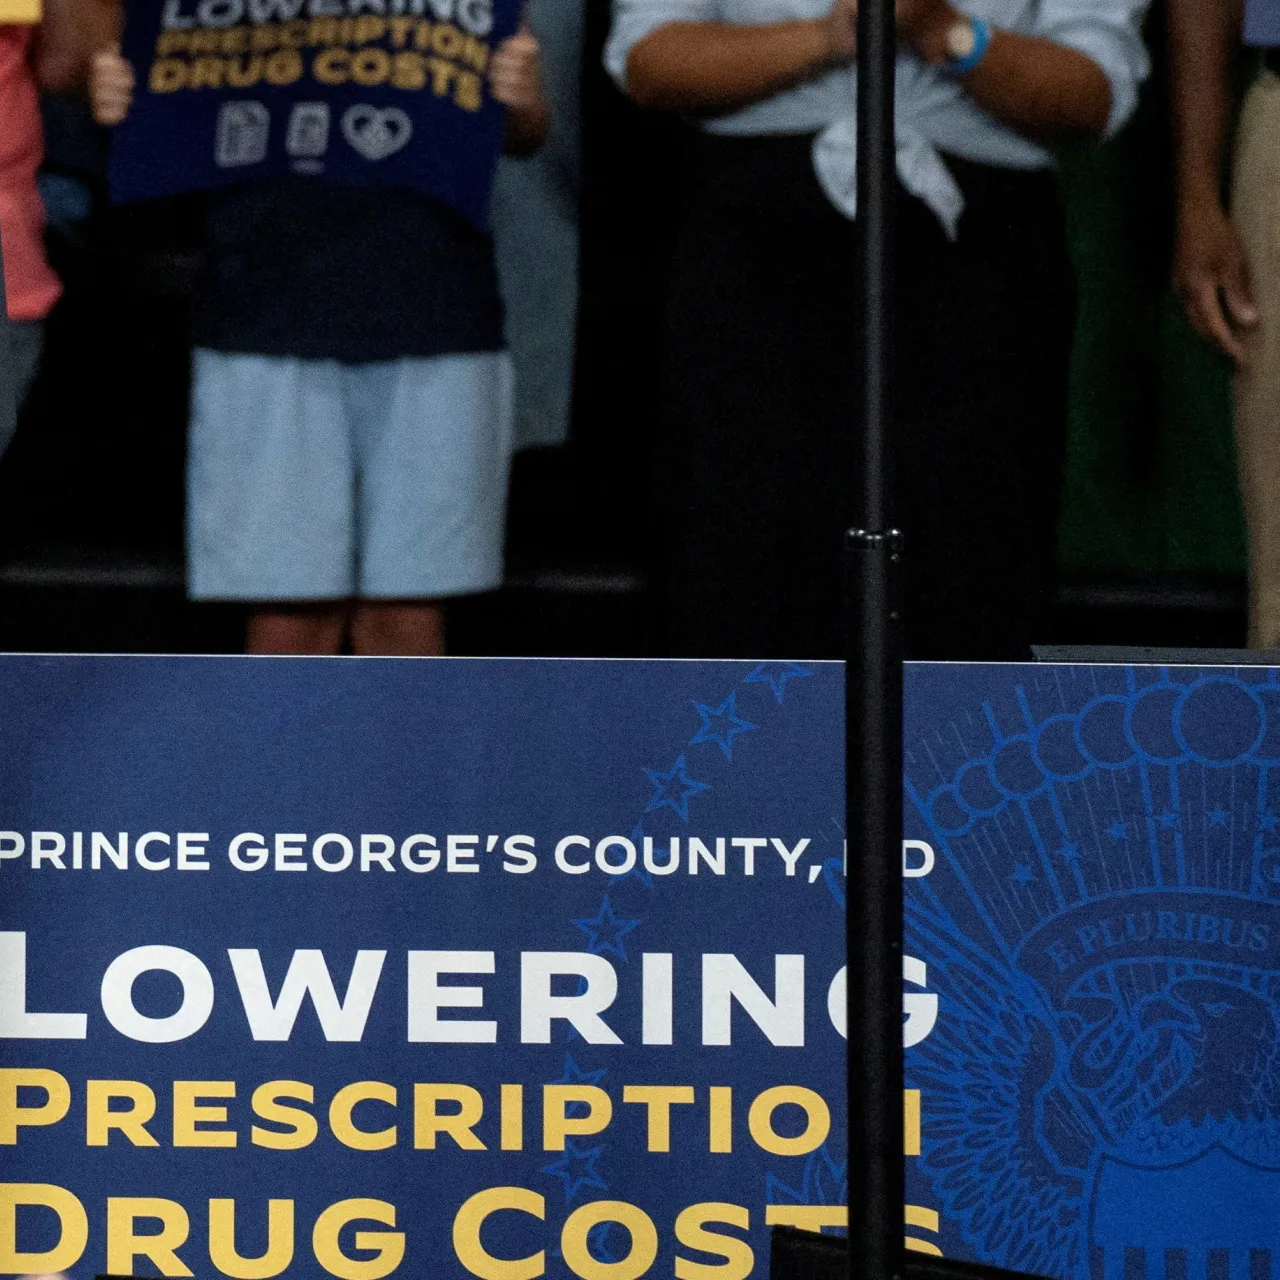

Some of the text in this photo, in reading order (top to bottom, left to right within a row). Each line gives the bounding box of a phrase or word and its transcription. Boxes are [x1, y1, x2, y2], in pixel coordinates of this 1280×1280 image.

[148, 47, 483, 112] DRUG COSTS
[228, 832, 538, 877] GEORGE'S
[554, 835, 823, 884] COUNTY,
[1049, 909, 1270, 972] E PLURIBUS
[452, 1186, 945, 1280] COS
